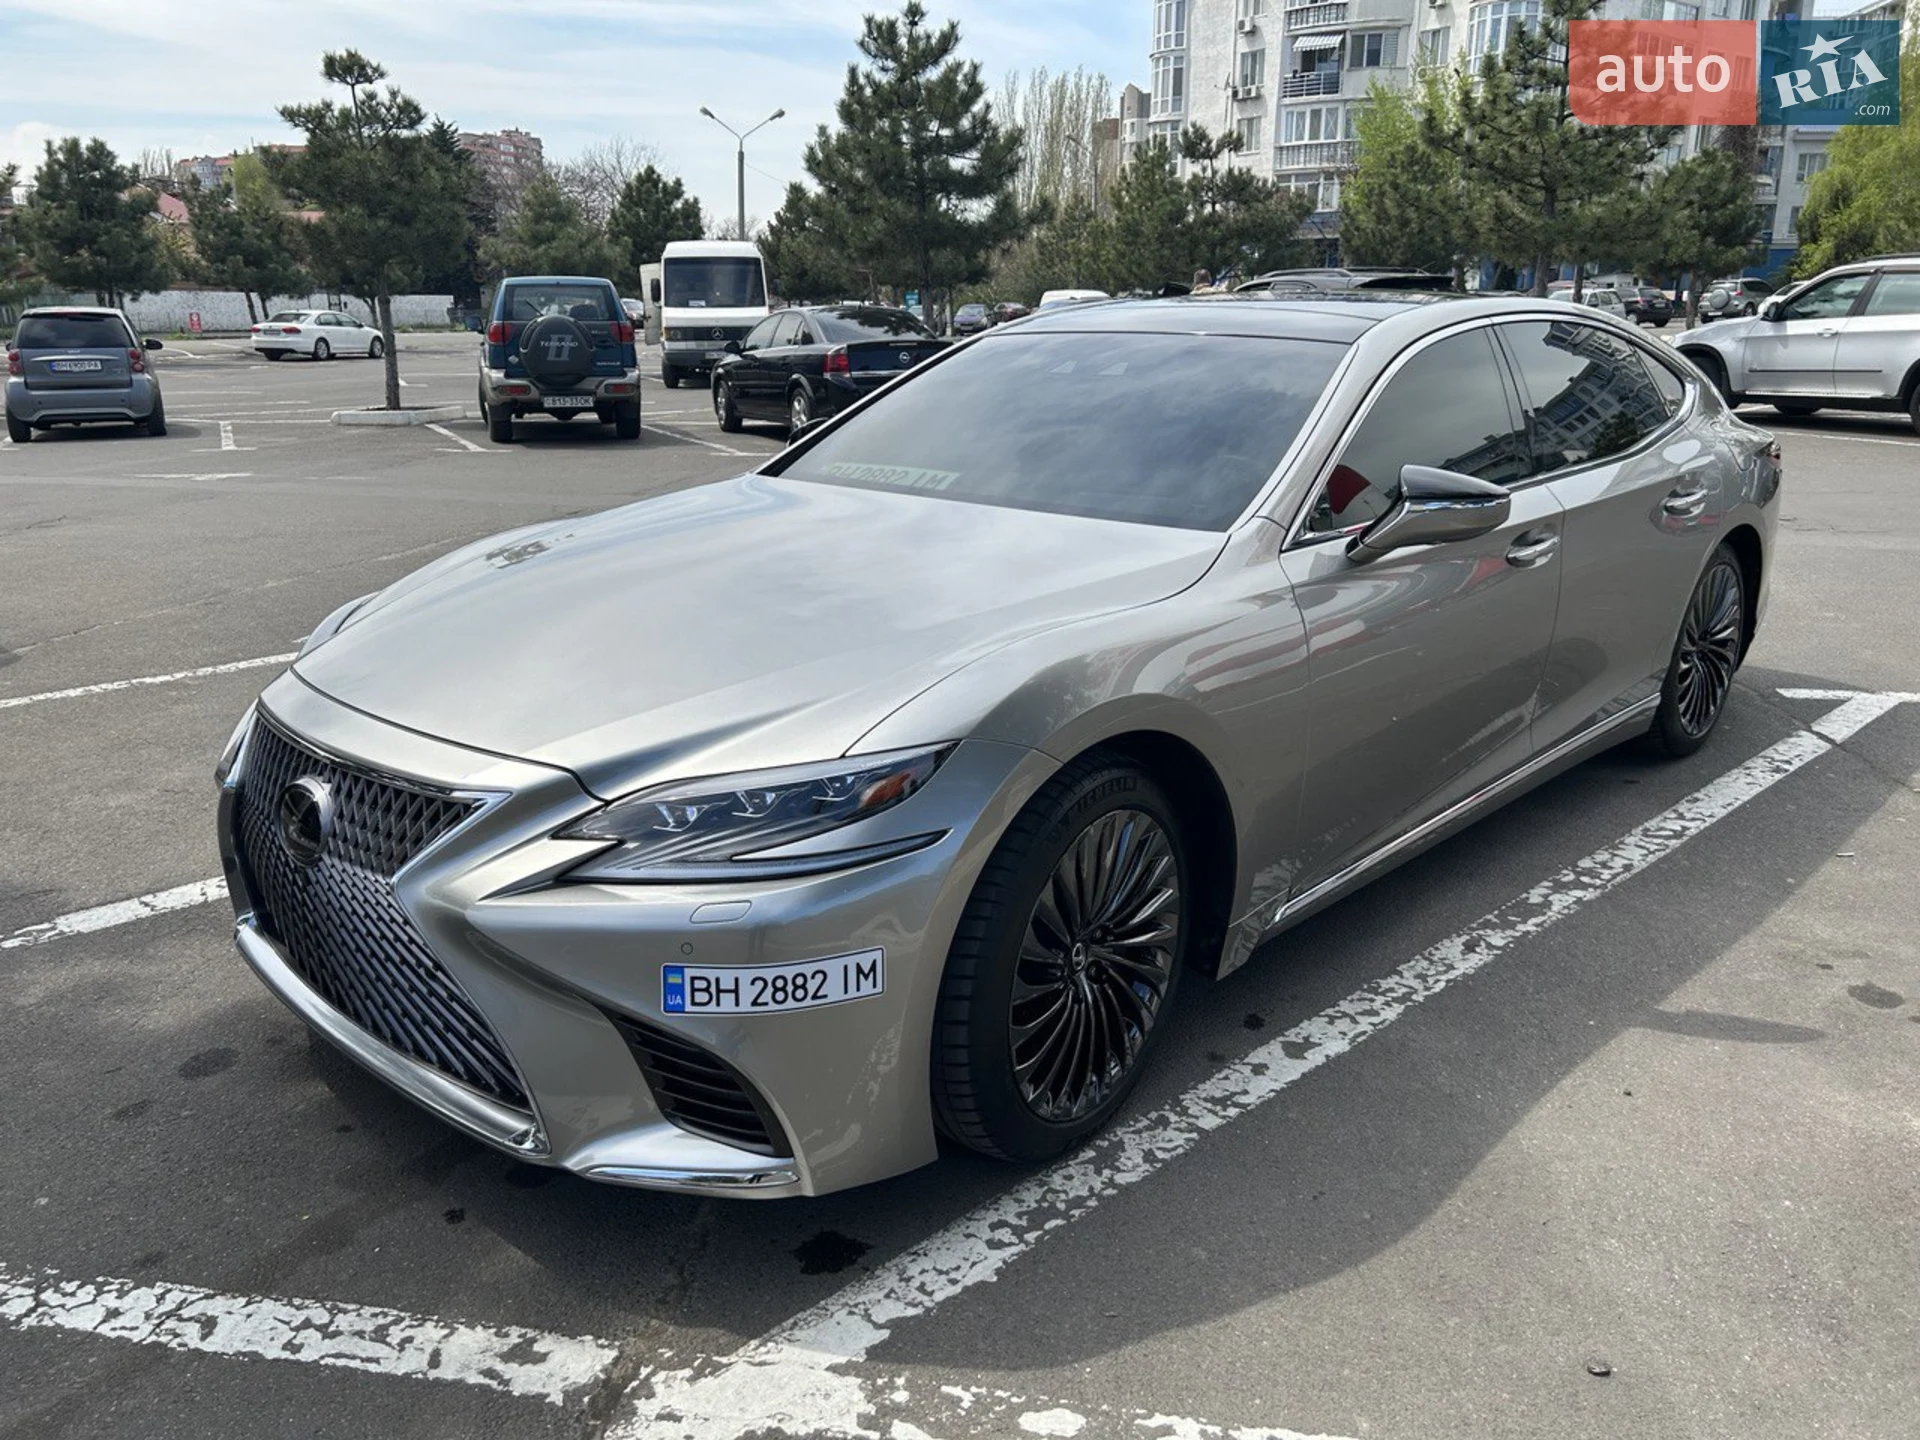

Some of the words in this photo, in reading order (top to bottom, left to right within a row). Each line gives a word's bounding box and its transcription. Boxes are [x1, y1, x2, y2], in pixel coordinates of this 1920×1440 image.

[689, 975, 740, 1007] BH
[750, 969, 828, 1007] 2882
[842, 959, 878, 995] IM
[668, 995, 683, 1005] UA
